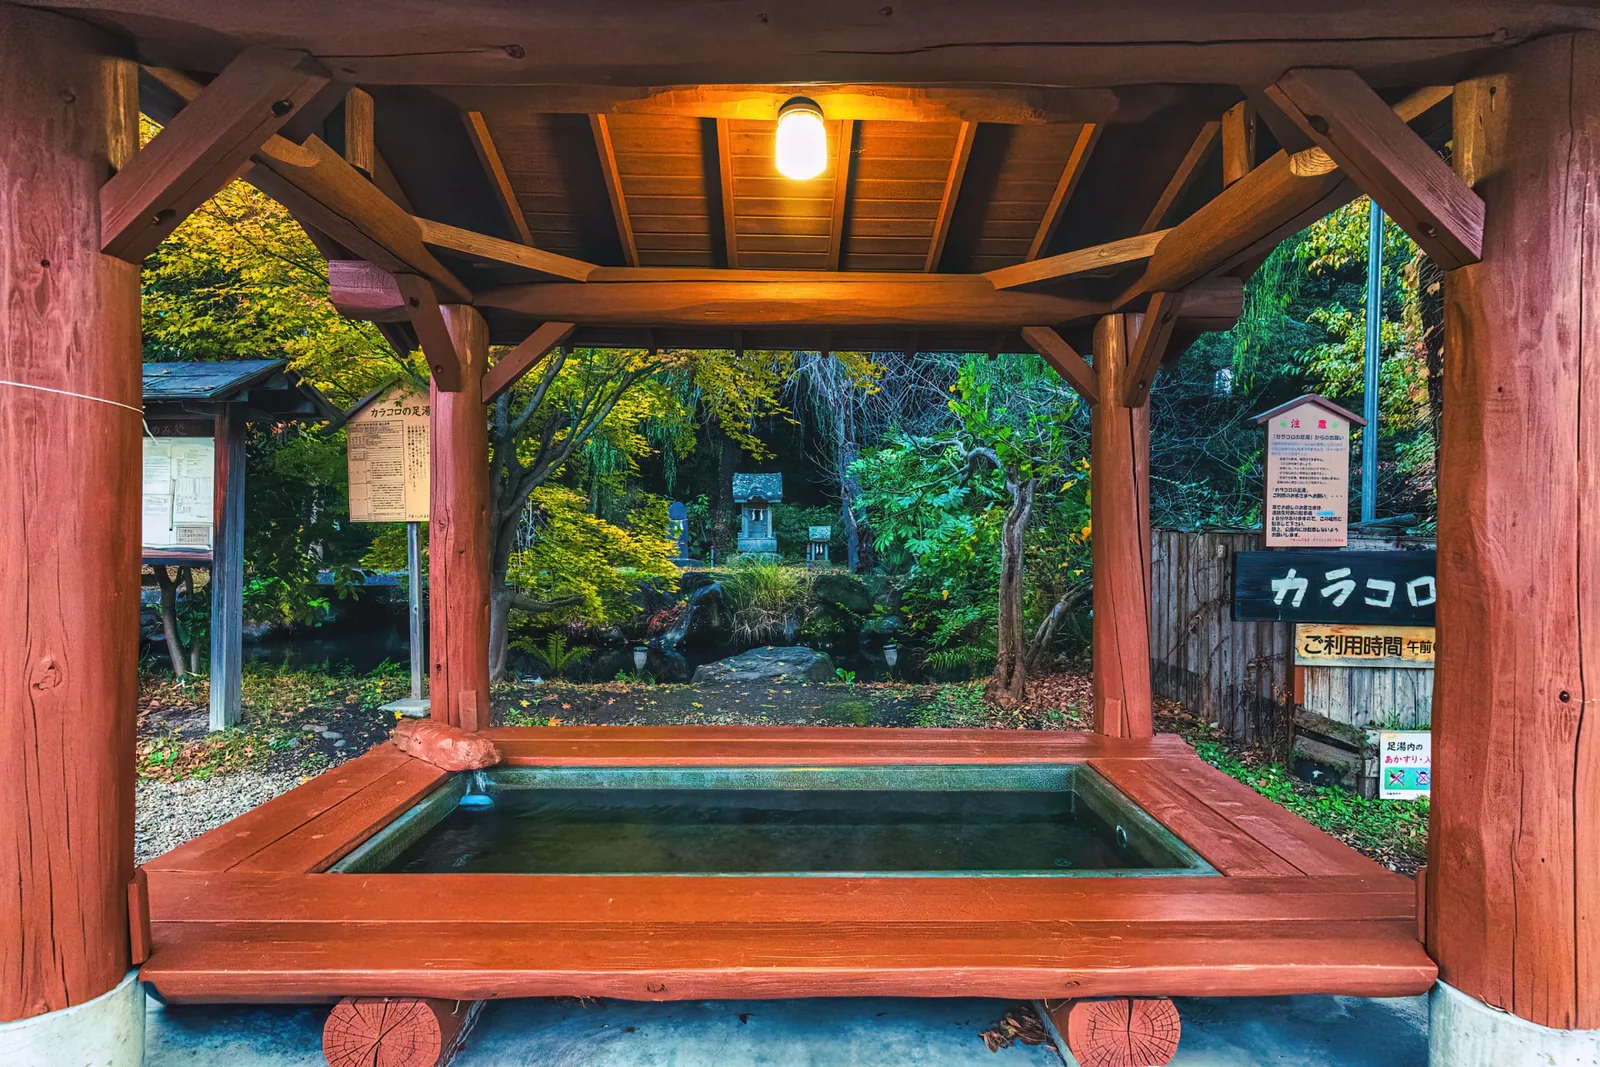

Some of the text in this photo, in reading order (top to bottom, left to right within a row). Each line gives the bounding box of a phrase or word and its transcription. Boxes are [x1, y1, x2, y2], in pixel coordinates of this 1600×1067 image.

[370, 405, 430, 418] カラコロの足湯
[1271, 567, 1436, 608] カラコロ
[1304, 634, 1436, 657] ご利用時間 午前
[1387, 741, 1424, 752] 足湯内の
